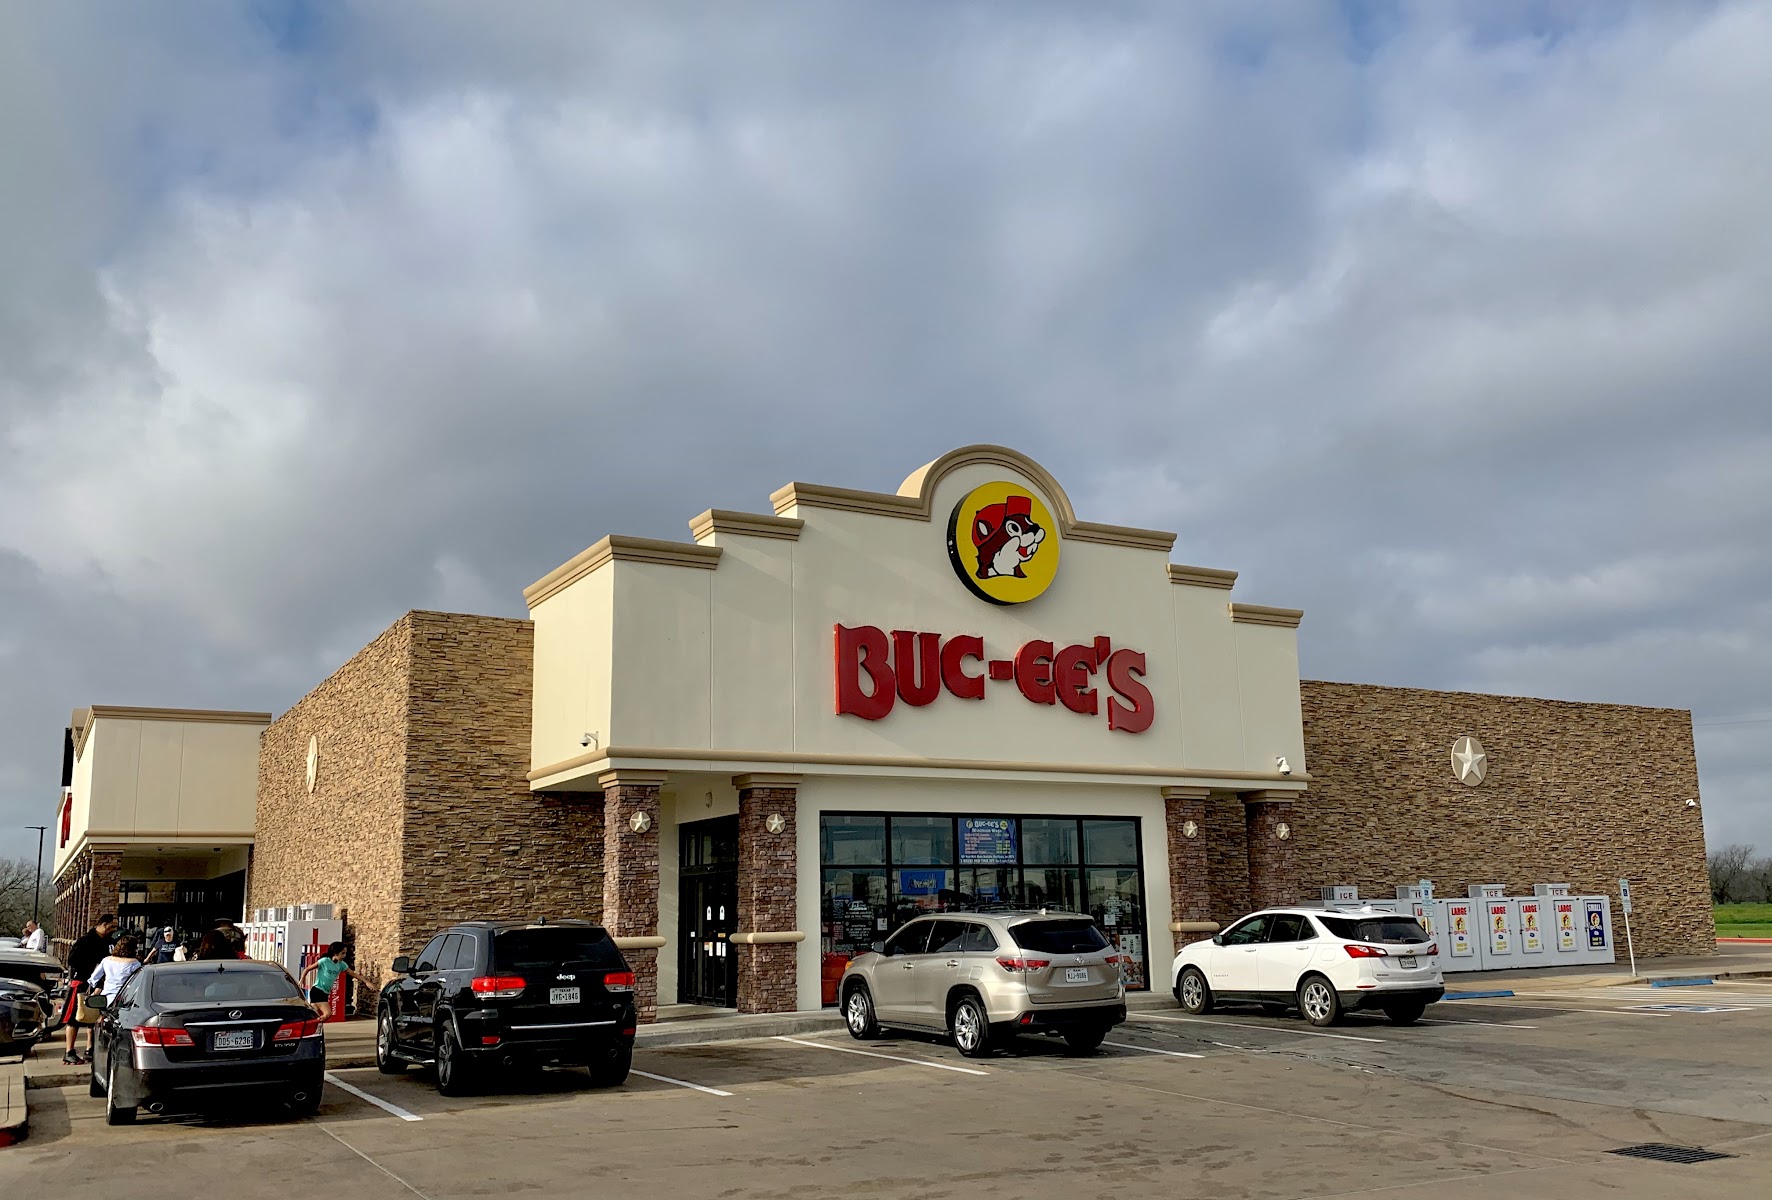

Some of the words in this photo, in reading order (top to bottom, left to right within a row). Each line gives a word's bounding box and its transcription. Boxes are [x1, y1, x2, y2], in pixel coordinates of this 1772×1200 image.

[1451, 907, 1467, 915] LARGE
[1491, 906, 1506, 914] LARGE
[1523, 905, 1537, 913] LARGE
[1558, 904, 1572, 912] LARGE
[1587, 903, 1602, 911] SMALL
[556, 973, 576, 981] Jeep
